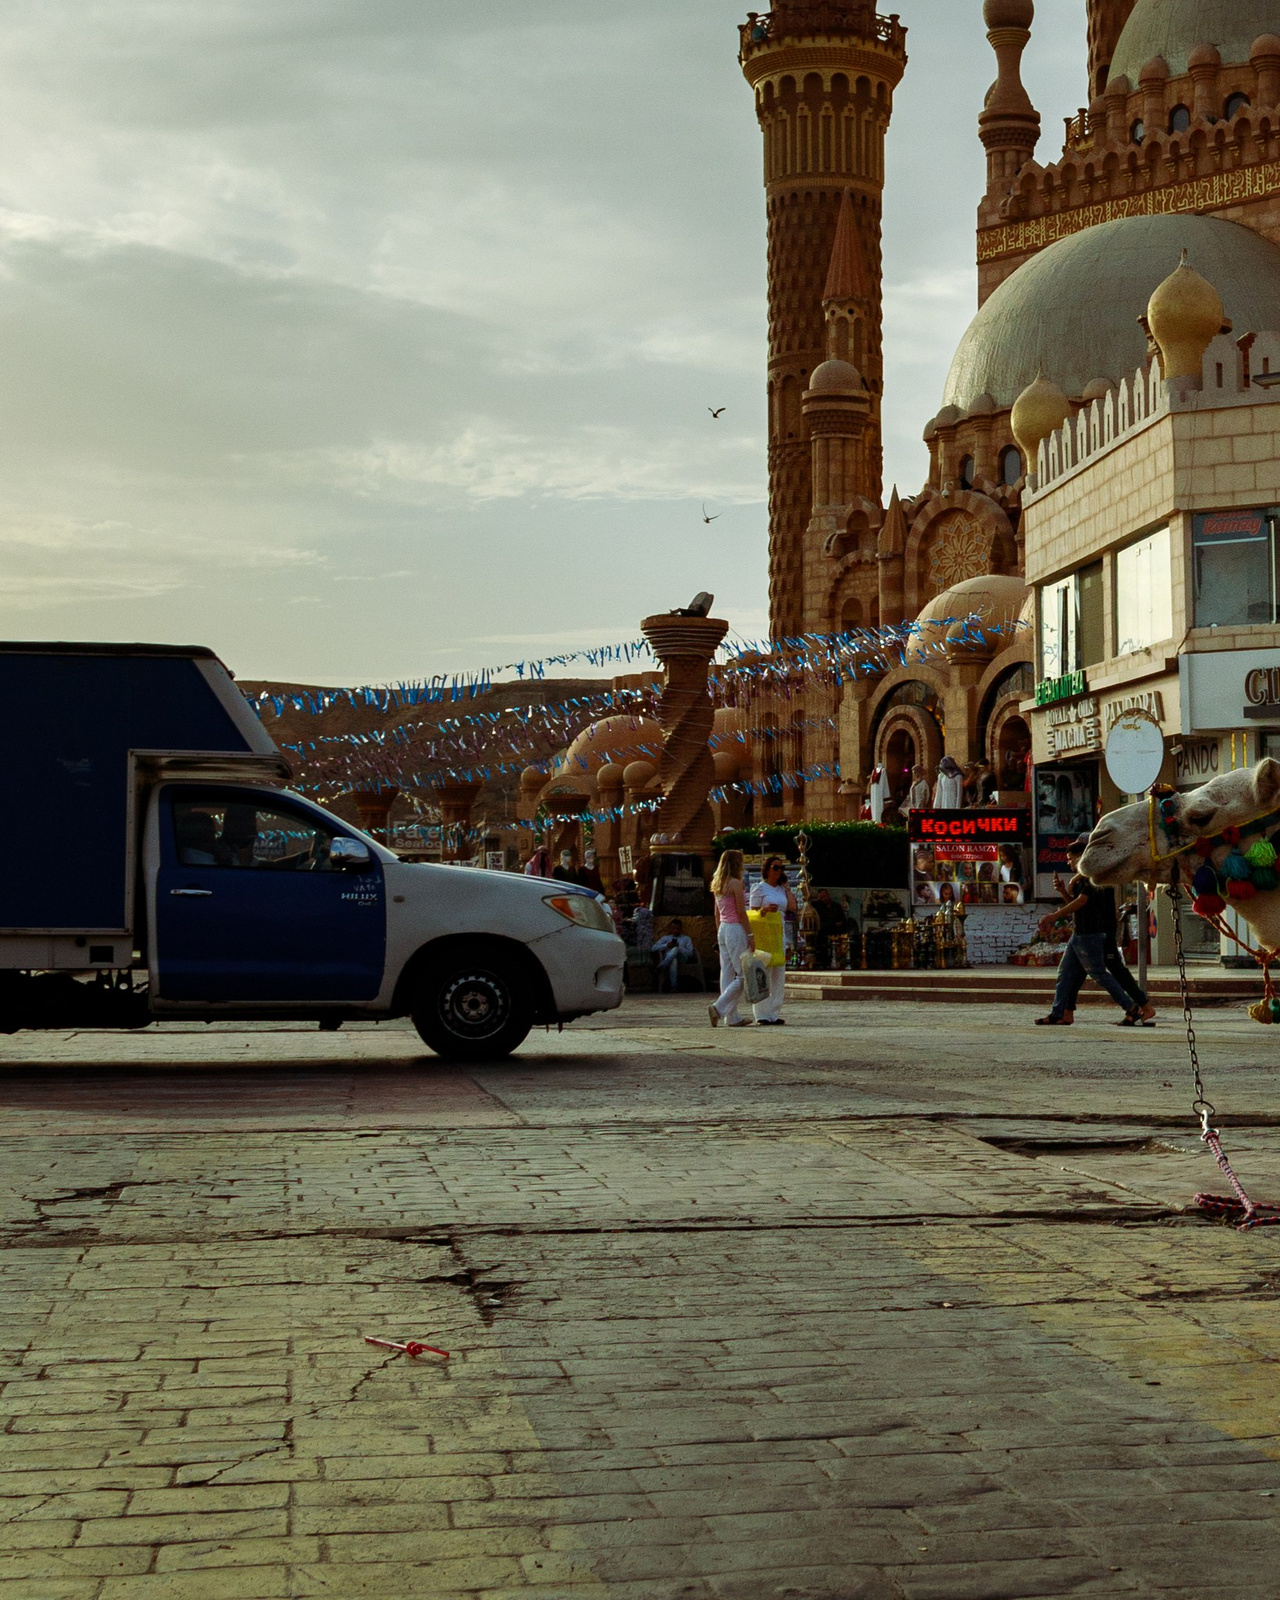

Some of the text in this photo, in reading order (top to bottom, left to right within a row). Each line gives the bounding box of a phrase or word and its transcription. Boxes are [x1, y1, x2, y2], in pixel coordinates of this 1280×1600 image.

[1203, 518, 1262, 536] Ramzy
[936, 844, 997, 853] SALON RAMZY
